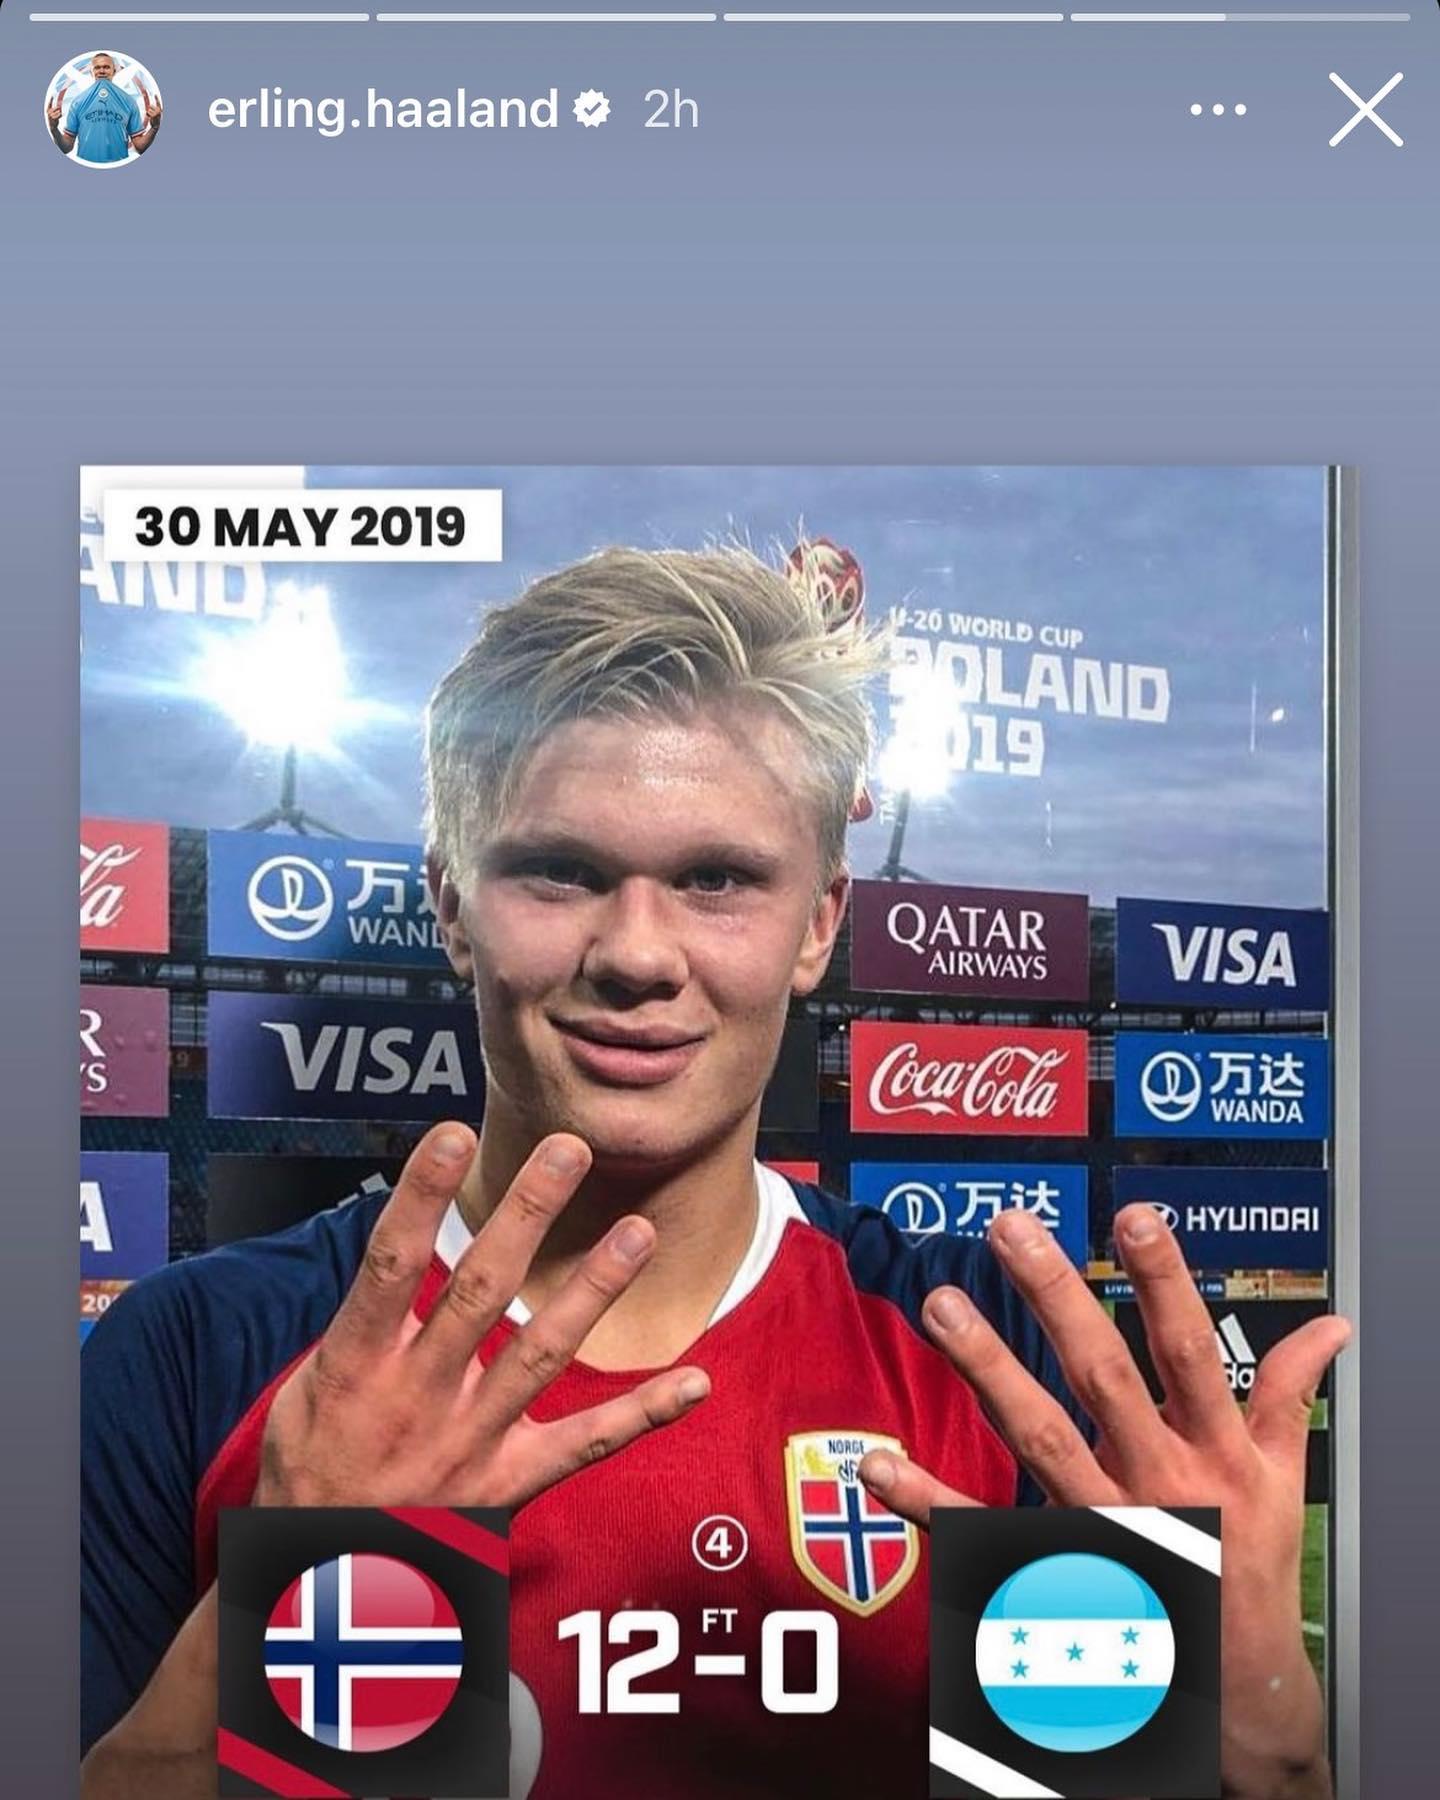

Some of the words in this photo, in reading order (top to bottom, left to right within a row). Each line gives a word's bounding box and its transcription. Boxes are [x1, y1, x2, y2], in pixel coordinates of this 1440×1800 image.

[948, 612, 1034, 643] WORLD
[1040, 623, 1084, 650] CUP
[889, 636, 1171, 724] POLAND
[887, 902, 1046, 954] QATAR
[928, 950, 1047, 980] AIRWAYS
[1151, 922, 1297, 987] VISA
[260, 1021, 468, 1096] VISA
[869, 1042, 1070, 1118] Coca-Cola
[1208, 1052, 1304, 1097] 万达
[1210, 1098, 1304, 1124] WANDA
[1187, 1205, 1319, 1232] HYUNDAI
